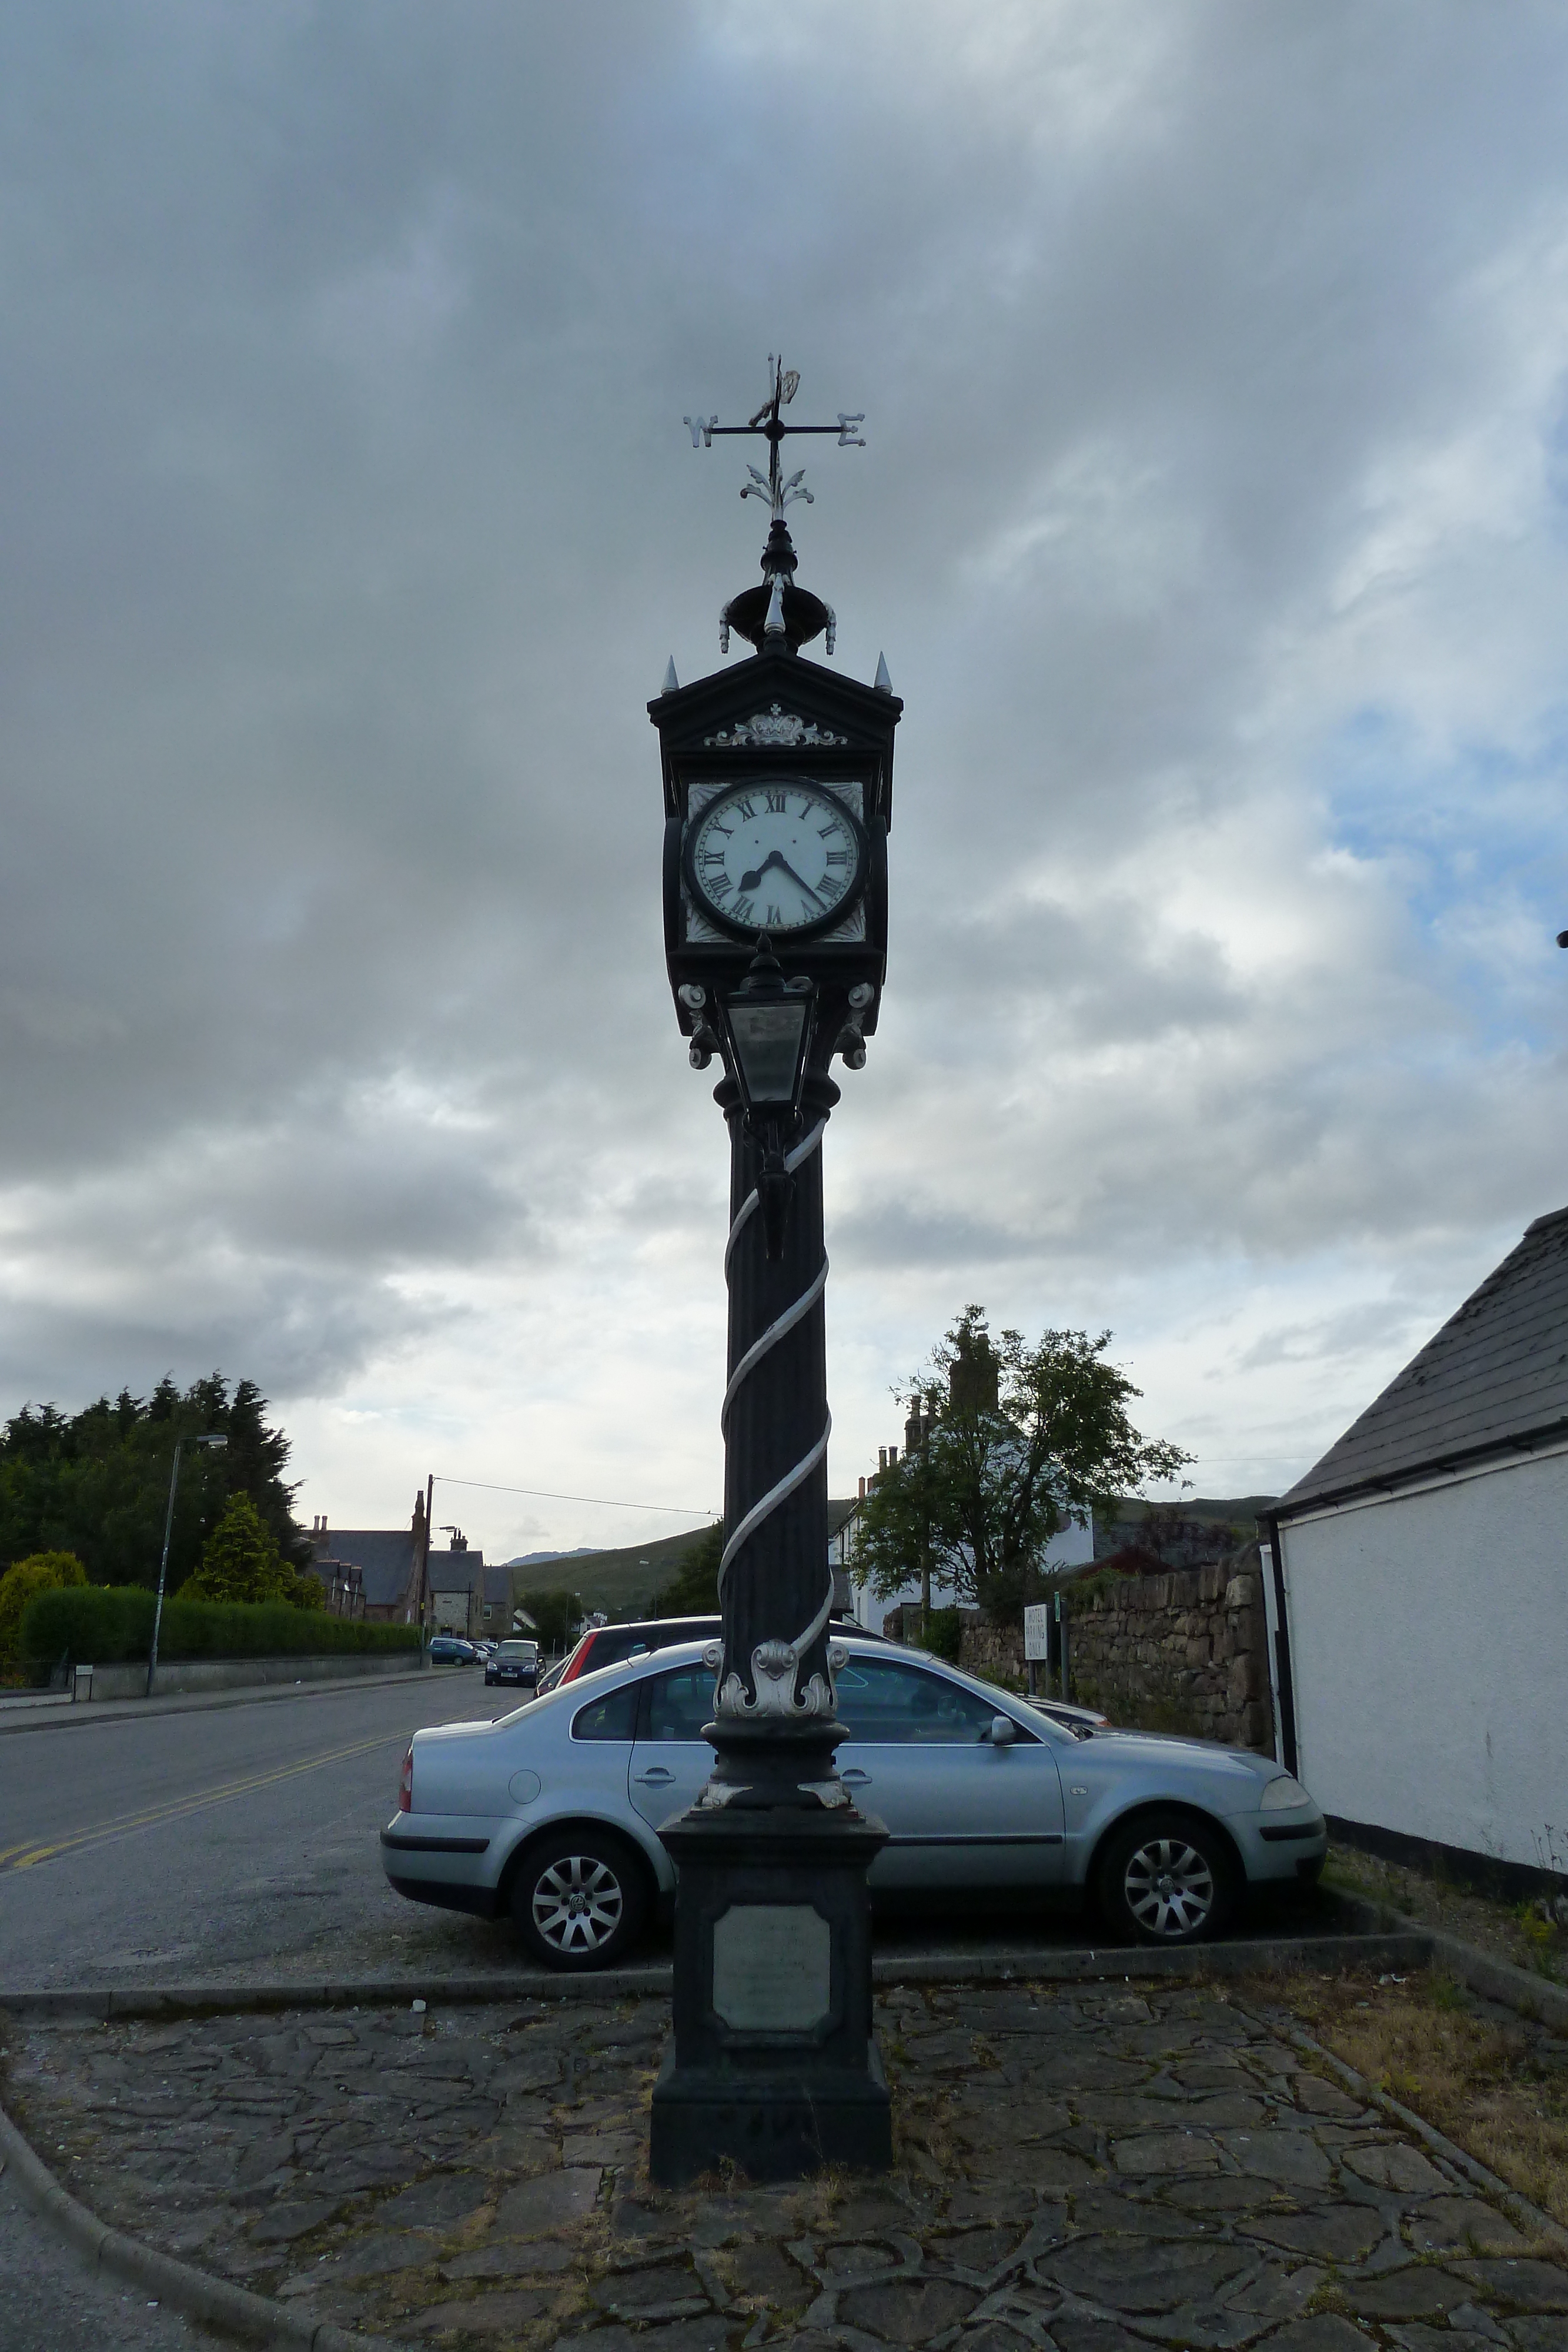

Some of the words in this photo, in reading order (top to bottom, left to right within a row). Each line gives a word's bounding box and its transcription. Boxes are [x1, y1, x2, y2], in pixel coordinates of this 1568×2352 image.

[683, 415, 718, 447] W
[837, 413, 866, 447] E
[735, 800, 757, 823] XI
[764, 794, 787, 813] XII
[798, 803, 814, 820] I
[712, 823, 734, 839] X
[817, 823, 840, 840] II
[704, 850, 725, 866] IX
[826, 851, 848, 867] III
[708, 872, 734, 901] VIII
[731, 895, 755, 920] VII
[766, 905, 782, 924] VI
[801, 900, 815, 918] V
[1028, 1608, 1043, 1623] HOTEL
[1025, 1624, 1045, 1639] PARKING
[1029, 1641, 1041, 1656] ONLY
